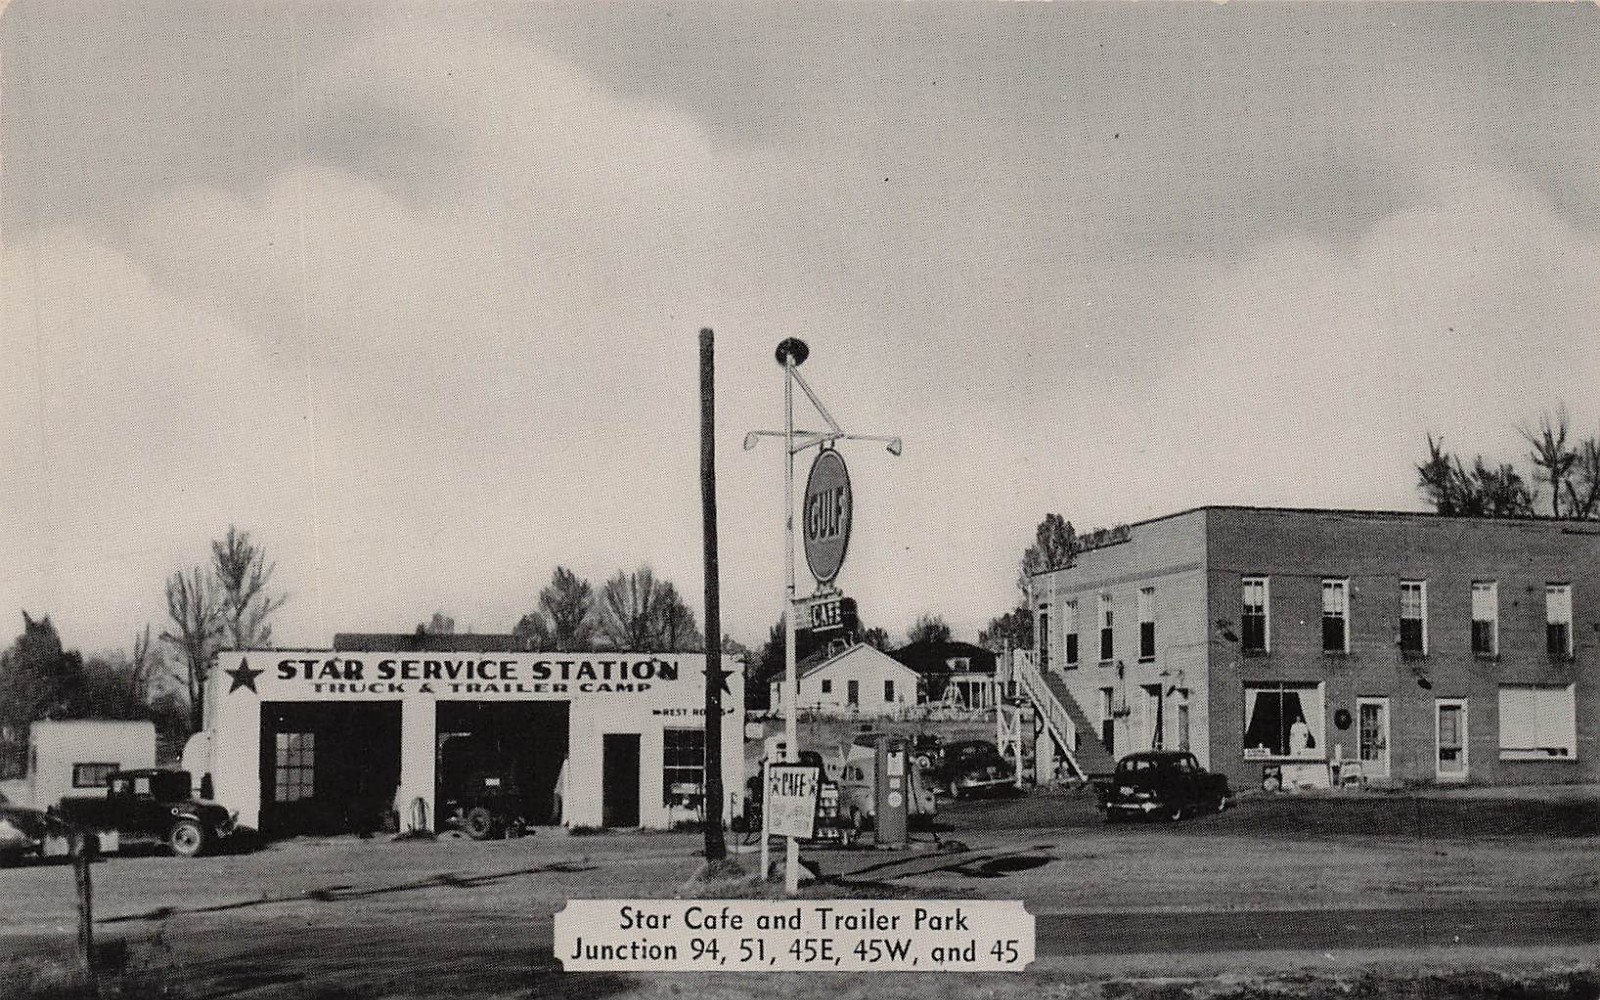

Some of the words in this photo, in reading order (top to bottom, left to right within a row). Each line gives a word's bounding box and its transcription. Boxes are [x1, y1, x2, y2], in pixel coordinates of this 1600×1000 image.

[809, 486, 844, 541] GULF
[812, 602, 841, 627] CAFE
[277, 660, 363, 680] STAR
[378, 660, 518, 680] SERVICE
[533, 660, 678, 681] STATION
[313, 682, 405, 694] TRUCK
[419, 682, 436, 694] &
[449, 682, 570, 694] TRAILER
[579, 682, 652, 693] CAMP
[663, 708, 687, 716] REST
[692, 708, 726, 716] ROS
[781, 772, 806, 797] CAFE
